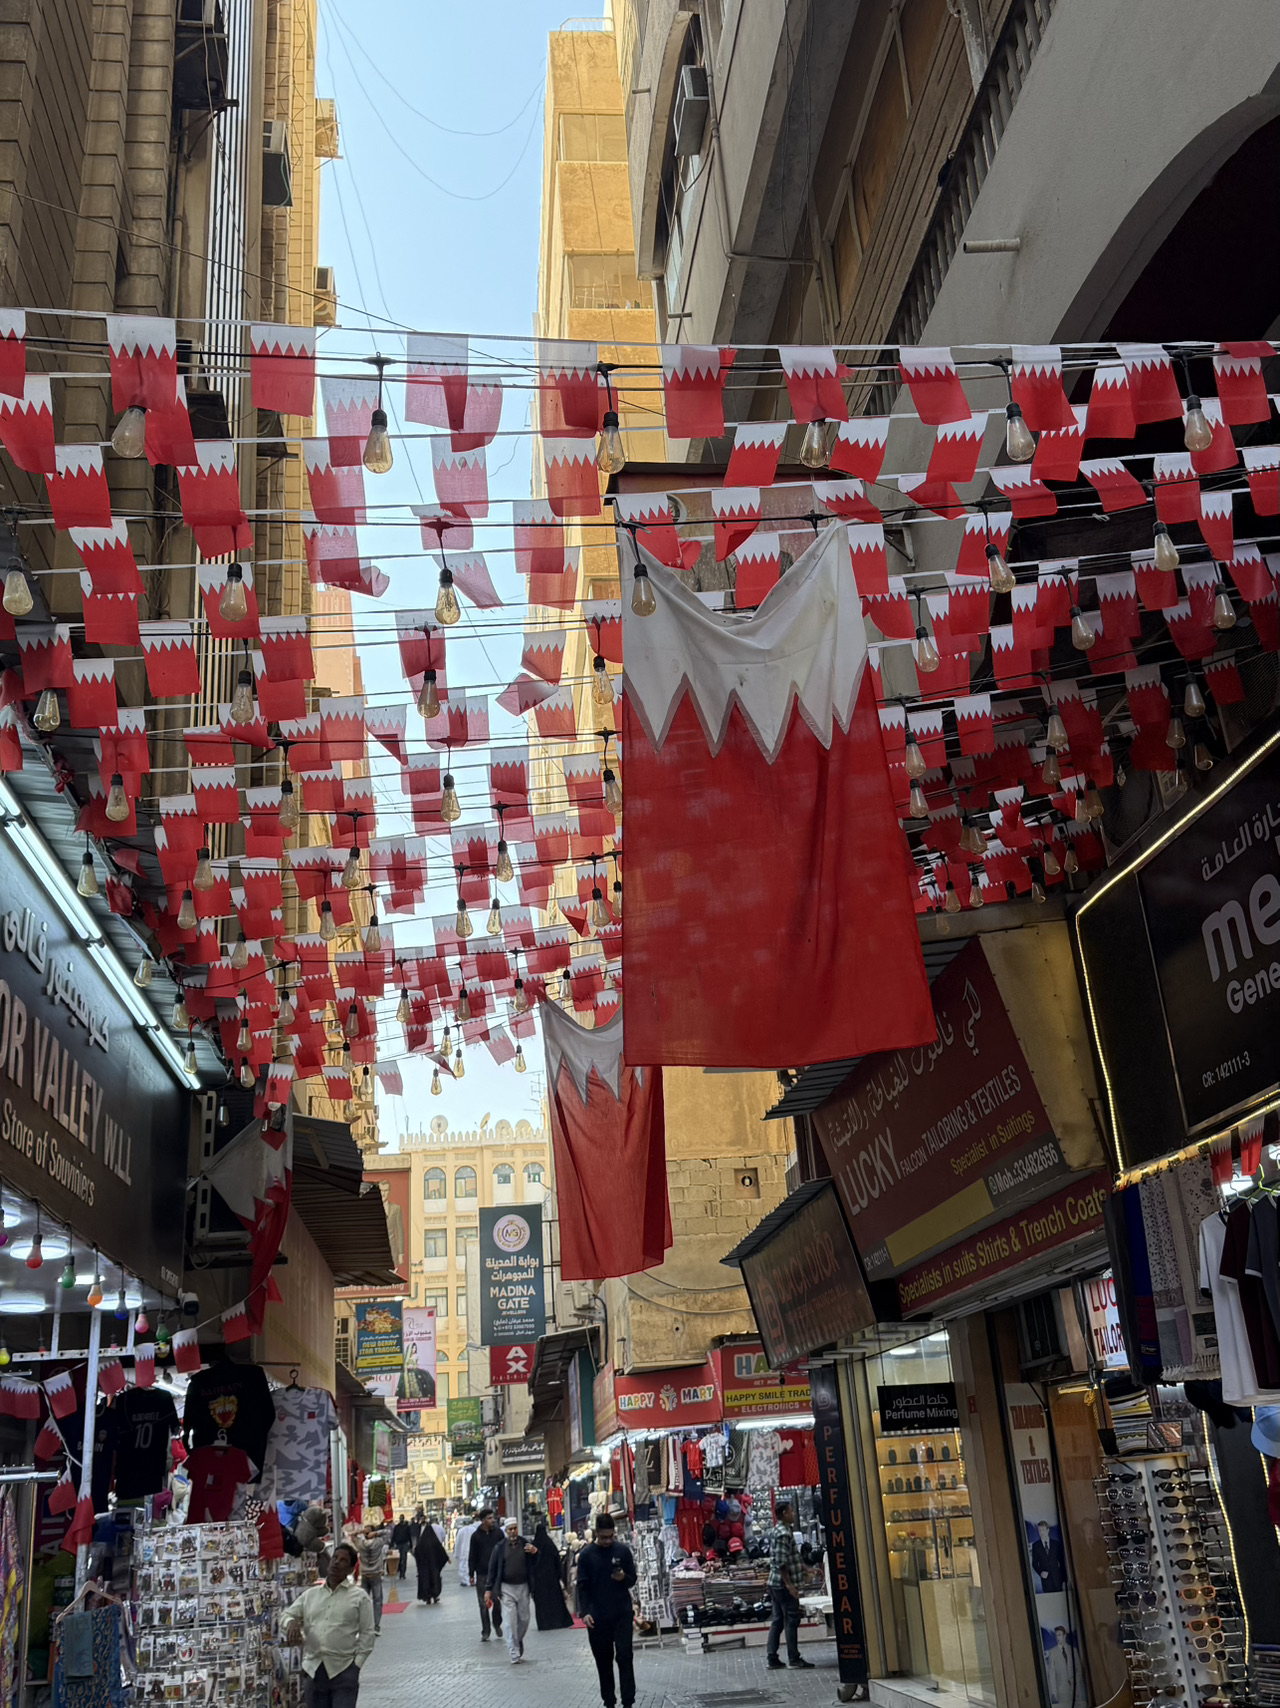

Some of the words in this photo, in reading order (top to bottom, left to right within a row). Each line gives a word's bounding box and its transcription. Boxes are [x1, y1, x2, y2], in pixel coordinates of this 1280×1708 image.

[1202, 1070, 1216, 1088] CR:
[1214, 1050, 1251, 1082] 142111-3
[33, 1016, 104, 1154] VALLEY
[971, 1064, 1022, 1119] TEXTILES
[965, 1099, 978, 1125] &
[2, 1098, 33, 1158] Store
[35, 1131, 48, 1169] of
[921, 1105, 968, 1156] TAILORING
[950, 1140, 990, 1176] Specialist
[987, 1132, 1001, 1151] in
[996, 1109, 1036, 1143] Suitings
[838, 1127, 902, 1216] LUCKY
[899, 1146, 928, 1178] FALCON
[804, 1231, 840, 1285] DIOR
[899, 1268, 942, 1307] Specialists
[941, 1261, 953, 1283] in
[953, 1249, 977, 1280] suits
[975, 1234, 1010, 1266] Shirts
[1009, 1226, 1021, 1252] &
[1019, 1204, 1066, 1246] Trench
[490, 1284, 536, 1298] MADINA
[497, 1297, 530, 1309] GATE
[734, 1353, 772, 1378] HA
[619, 1393, 654, 1410] HAPPY
[681, 1385, 714, 1403] MART
[726, 1393, 757, 1402] HAPPY
[758, 1390, 785, 1400] SMILE
[741, 1402, 799, 1413] ELECTRONICS
[892, 1395, 925, 1409] العطور
[927, 1394, 948, 1405] خلط
[885, 1409, 925, 1420] Perfume
[927, 1407, 958, 1418] Mixing
[135, 1423, 153, 1448] 10
